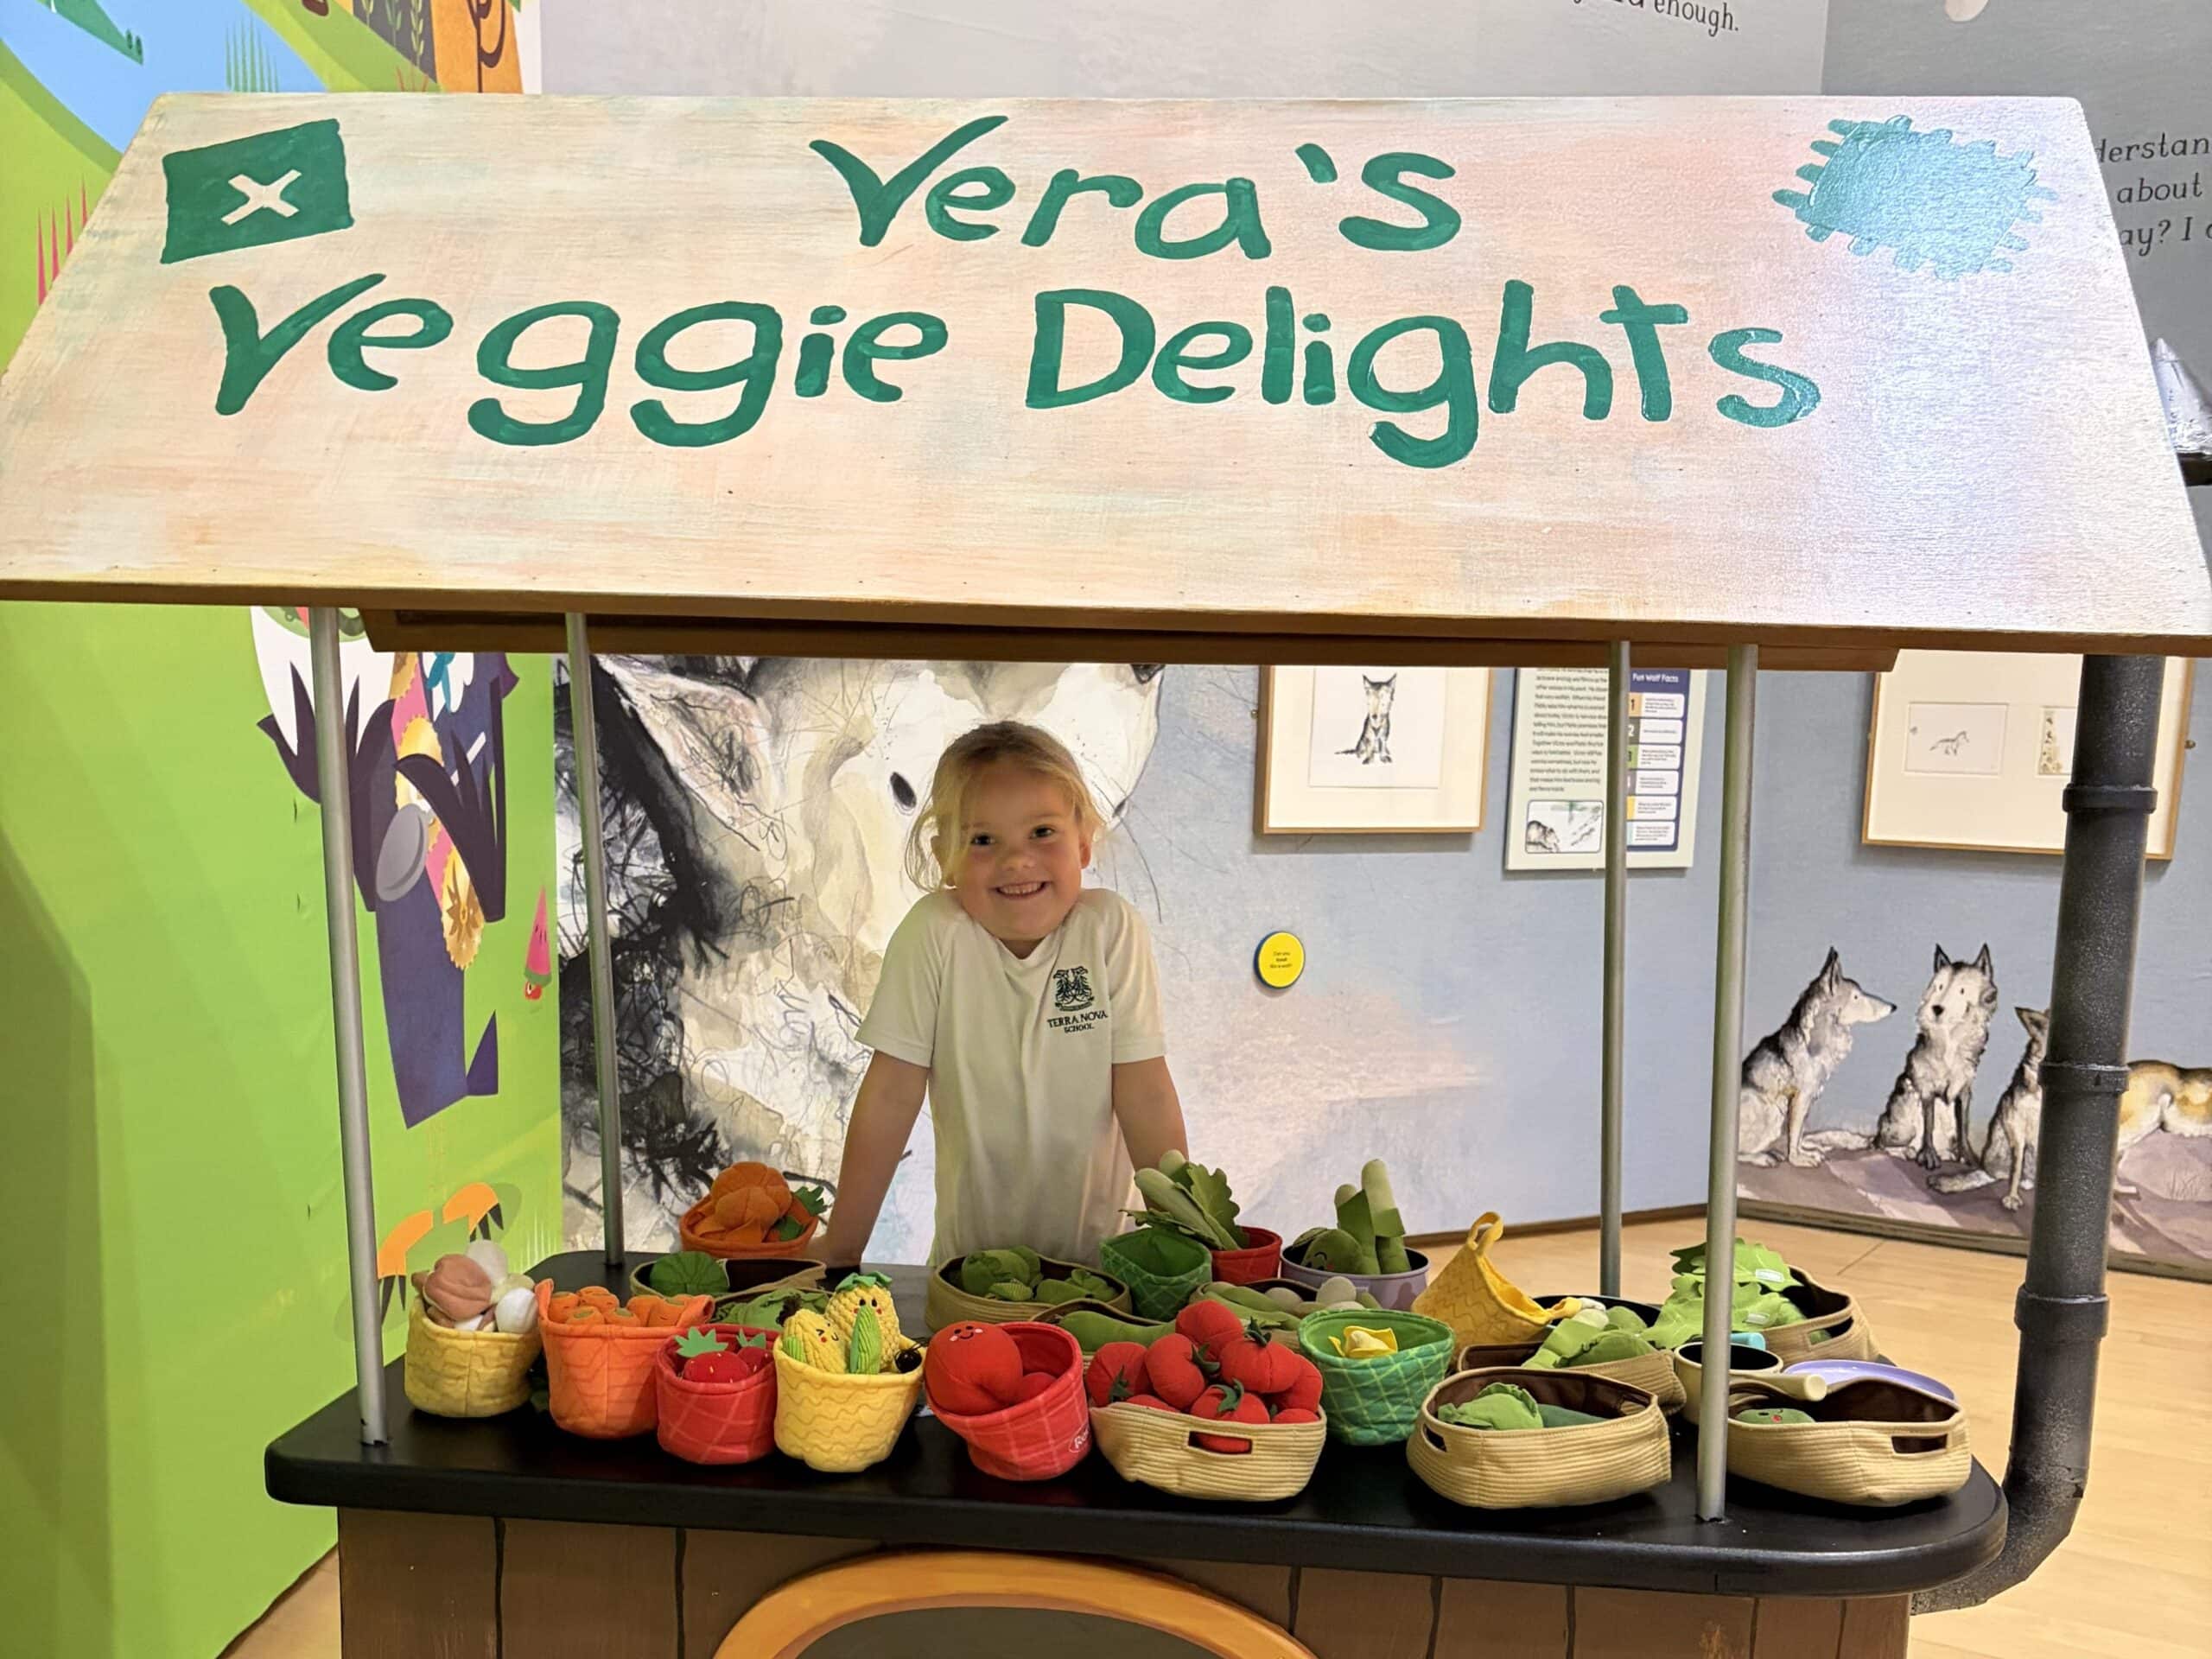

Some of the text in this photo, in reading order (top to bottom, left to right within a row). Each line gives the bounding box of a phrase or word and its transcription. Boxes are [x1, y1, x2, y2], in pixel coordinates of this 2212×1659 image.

[1654, 0, 1739, 37] enough.
[810, 116, 1462, 259] Vera's
[2117, 172, 2202, 204] about
[2181, 216, 2194, 241] I
[209, 273, 1821, 468] Veggie Delights
[1628, 724, 1635, 737] 2
[1046, 1010, 1109, 1028] TERRA NOVA
[1064, 1023, 1095, 1033] SCHOOL
